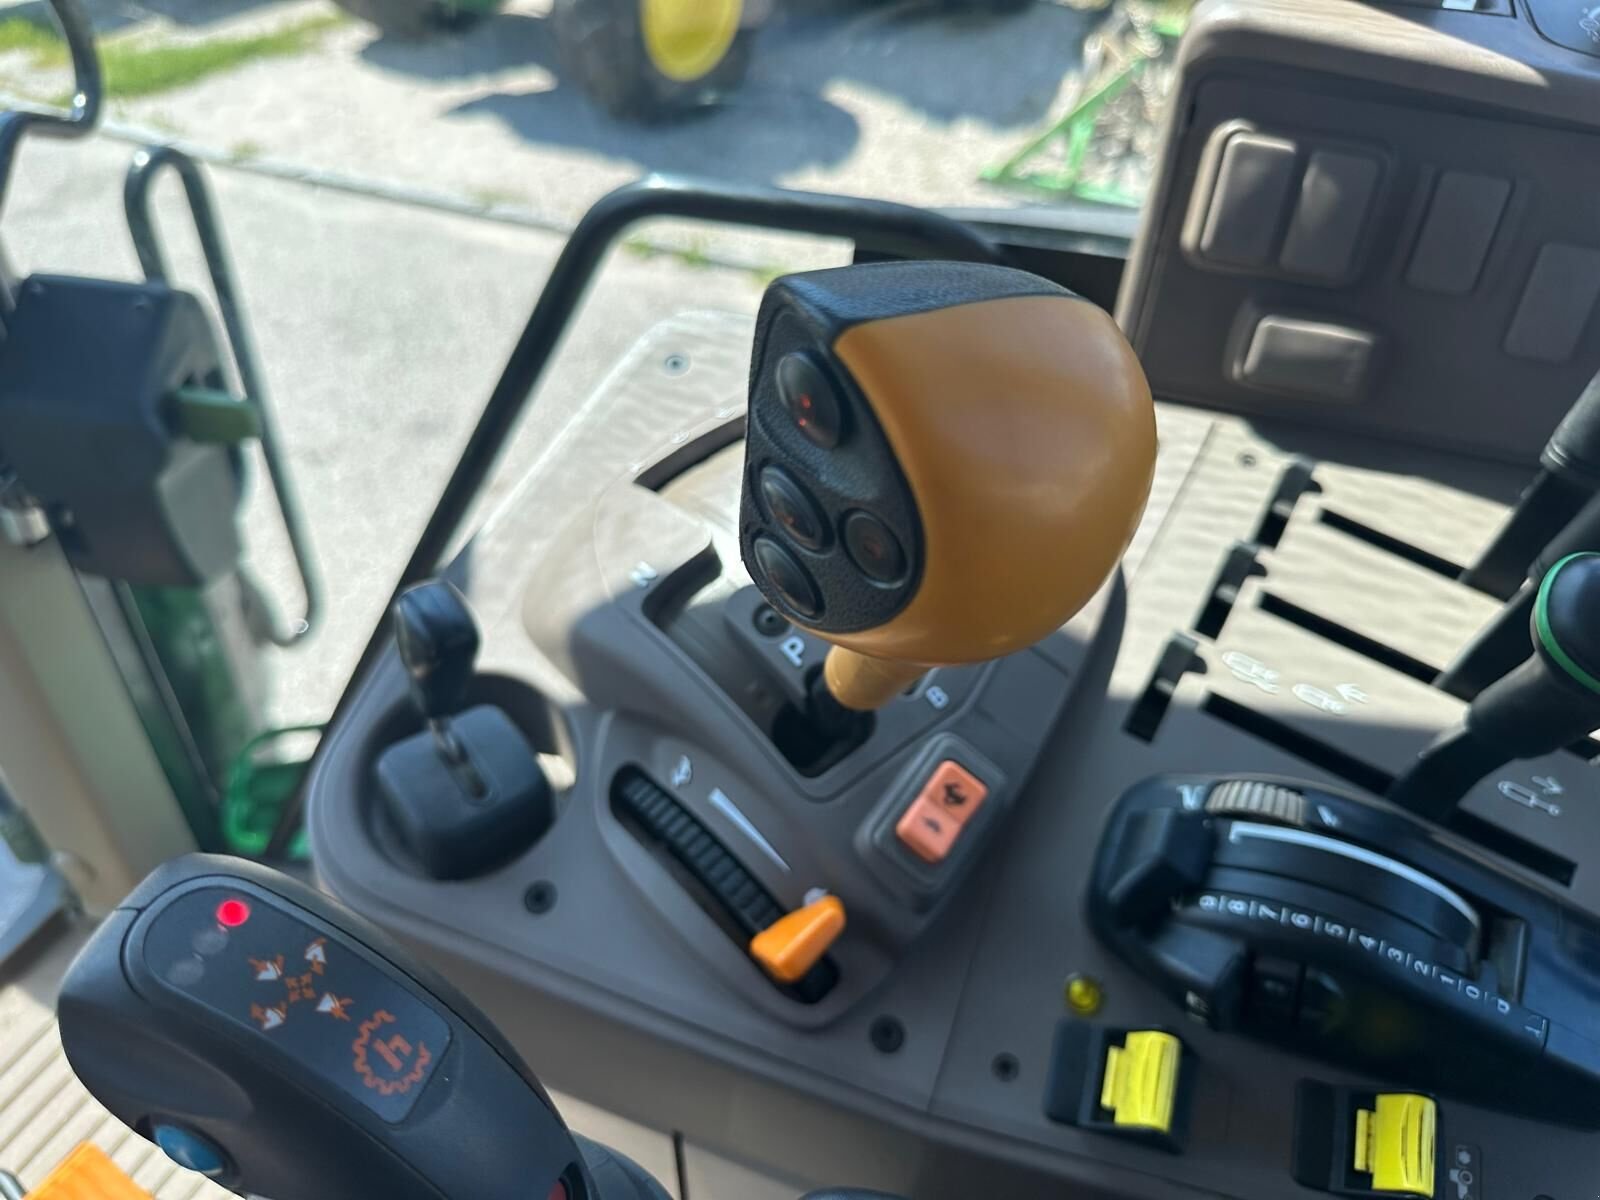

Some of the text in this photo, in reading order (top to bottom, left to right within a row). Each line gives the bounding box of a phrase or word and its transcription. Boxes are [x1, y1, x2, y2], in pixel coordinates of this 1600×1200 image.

[781, 637, 805, 667] P
[1258, 904, 1280, 921] 7
[1290, 912, 1313, 929] 6
[1324, 922, 1345, 938] 5
[1358, 935, 1378, 951] 4
[1387, 947, 1402, 962] 3
[1414, 960, 1429, 976] 2
[1439, 974, 1455, 985] 1
[1465, 985, 1480, 1000] 0
